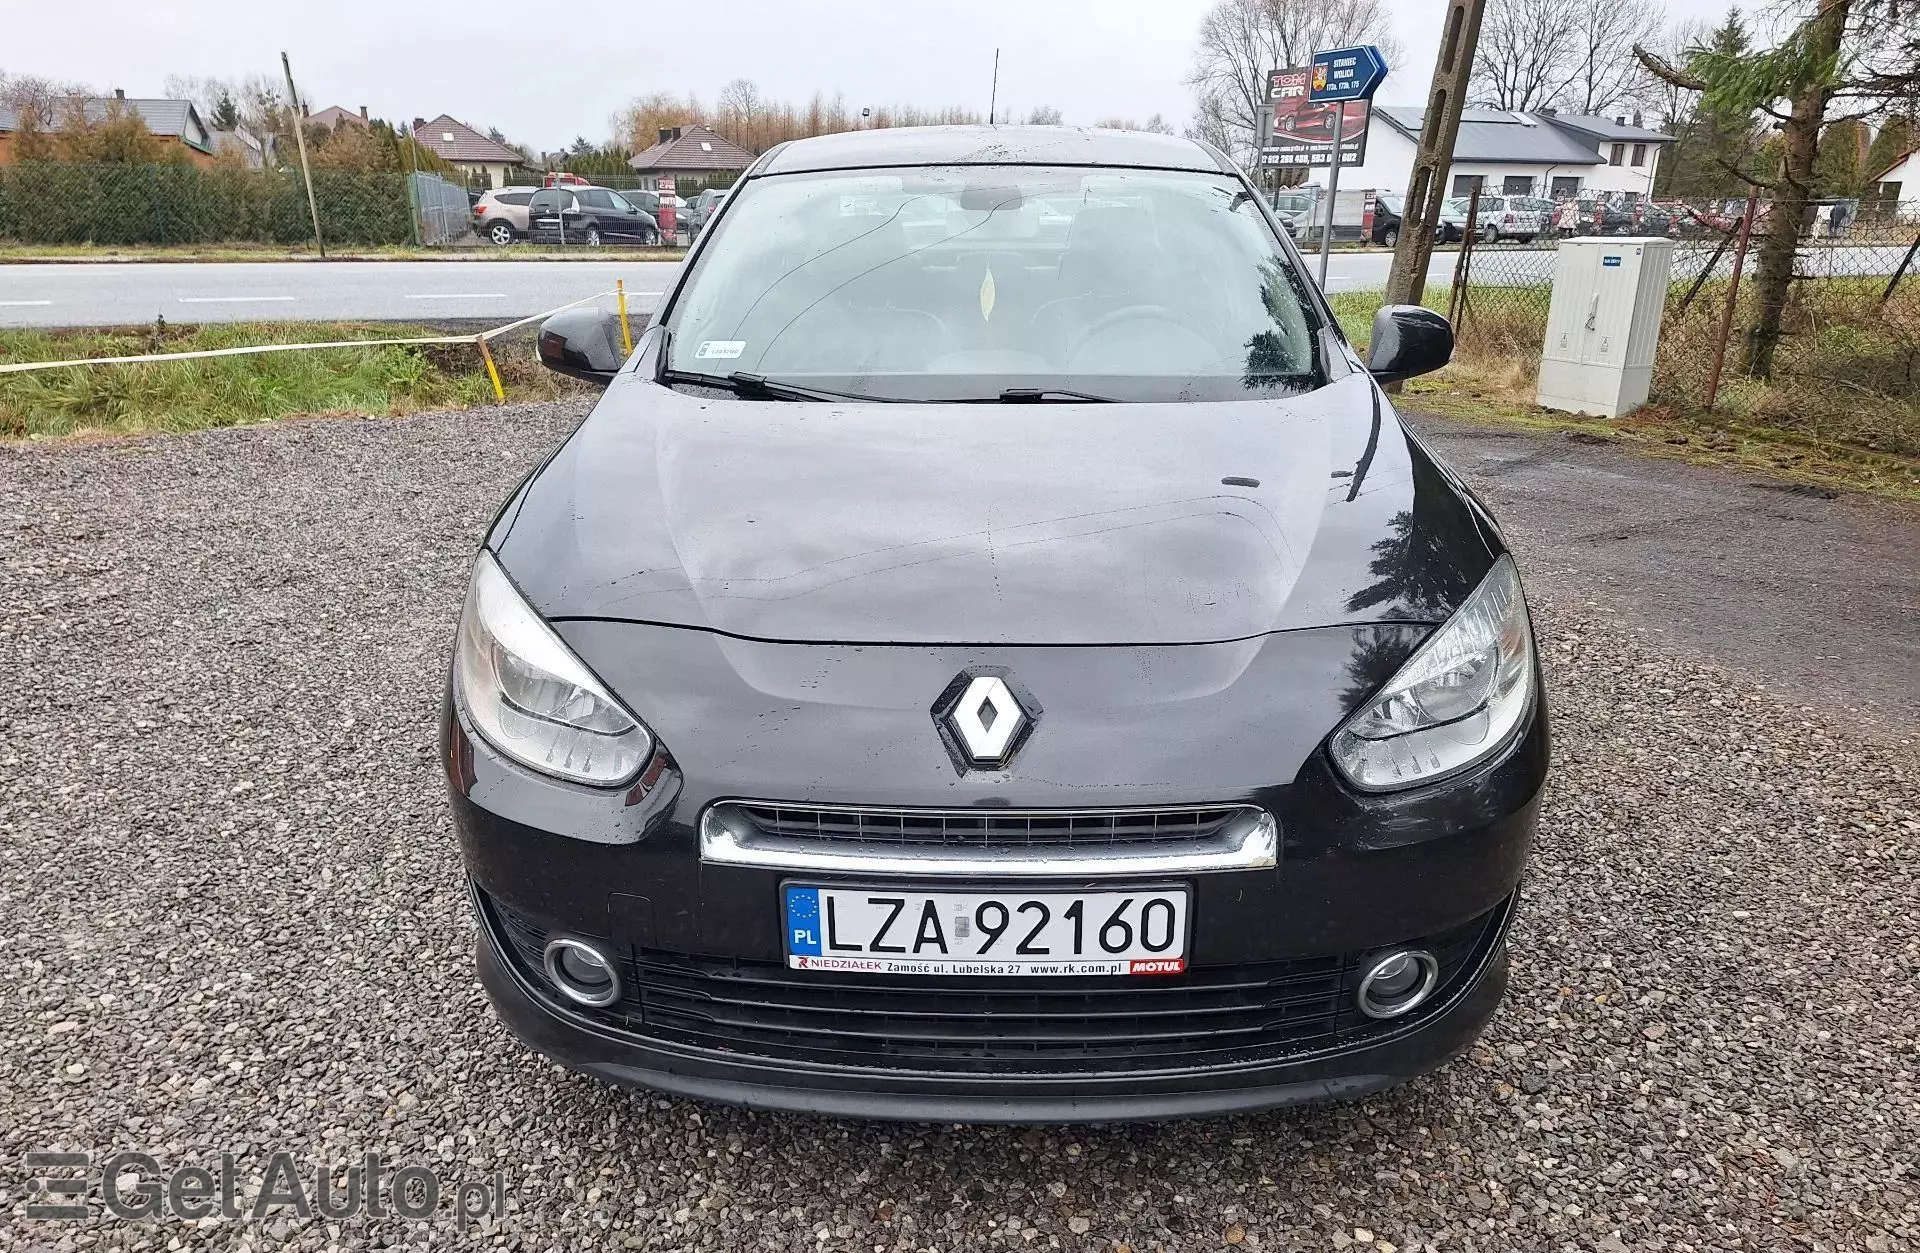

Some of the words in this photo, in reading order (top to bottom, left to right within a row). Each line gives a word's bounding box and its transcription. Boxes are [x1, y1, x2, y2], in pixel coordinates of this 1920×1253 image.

[1271, 73, 1306, 87] TOM
[1270, 86, 1304, 98] CAR
[826, 896, 949, 954] LZA
[975, 898, 1175, 955] 92160
[794, 929, 816, 945] PL
[811, 959, 882, 970] NIEDZIAŁEK
[887, 962, 930, 973] Zamość
[933, 963, 948, 974] ul.
[952, 963, 1004, 974] Lubelska
[1007, 964, 1021, 974] 27
[1030, 962, 1122, 976] www.rk.com.pl
[1132, 961, 1181, 972] MOTUL
